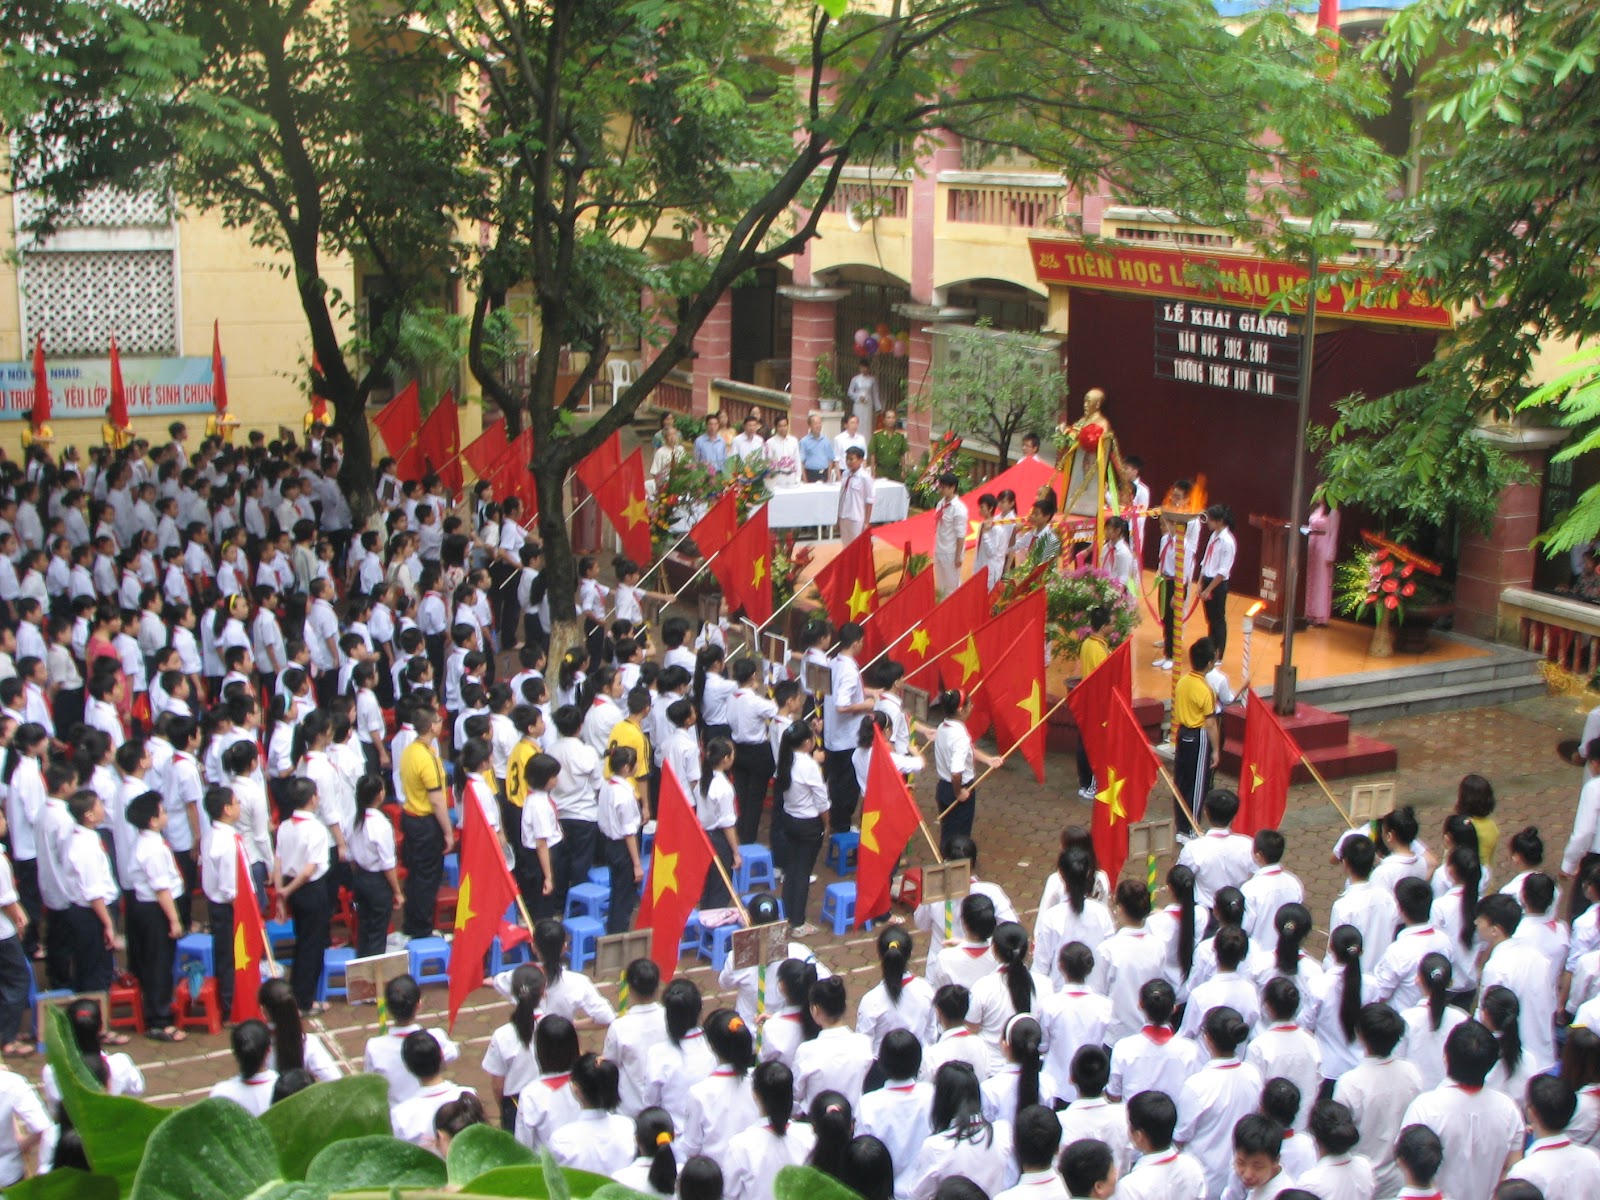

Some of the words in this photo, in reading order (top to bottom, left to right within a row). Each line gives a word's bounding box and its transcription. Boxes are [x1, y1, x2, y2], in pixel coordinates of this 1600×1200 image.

[1118, 259, 1163, 287] HỌC
[1190, 307, 1231, 330] KHAI
[64, 383, 84, 408] YÊU
[155, 384, 180, 406] SINH
